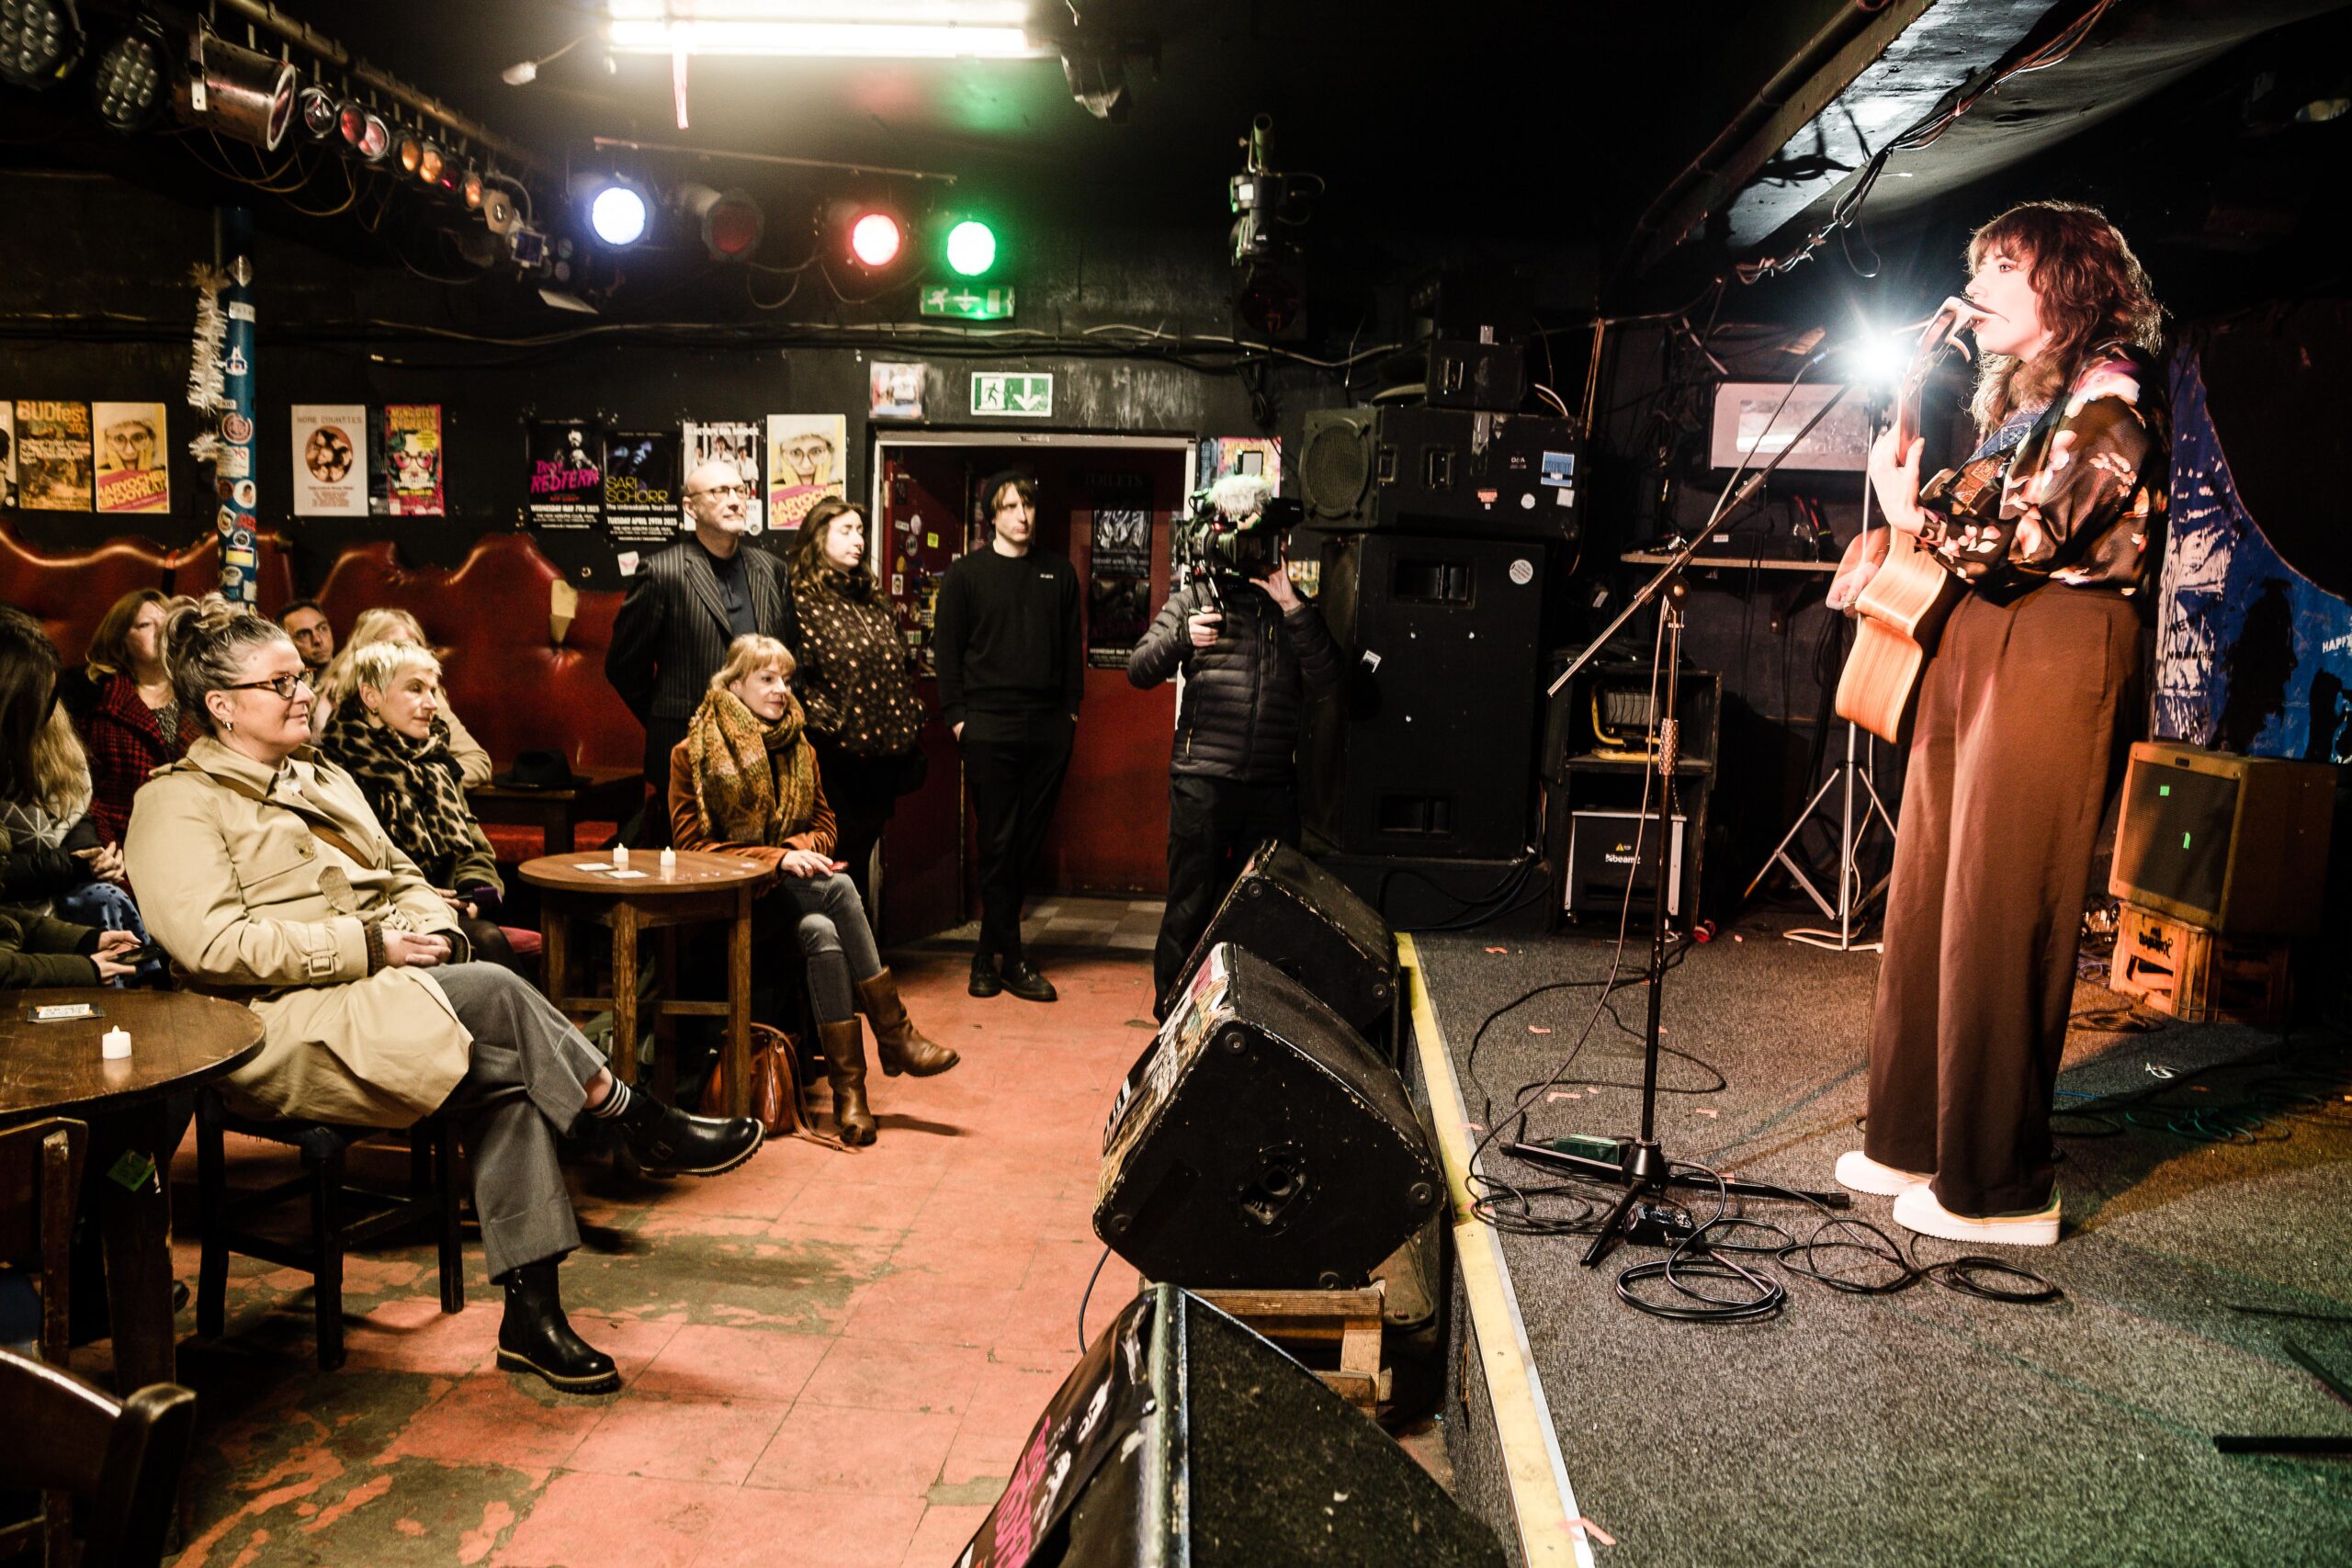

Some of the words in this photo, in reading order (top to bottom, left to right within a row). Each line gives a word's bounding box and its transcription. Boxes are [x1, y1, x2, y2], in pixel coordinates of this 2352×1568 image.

[17, 400, 87, 422] BUDfest
[537, 460, 563, 474] TROY
[531, 469, 599, 492] REDFERN
[605, 477, 637, 491] SARI
[605, 490, 668, 503] SCHORR
[607, 516, 631, 525] TUESDAY
[663, 517, 678, 525] 2025
[2323, 633, 2352, 653] HAPPY
